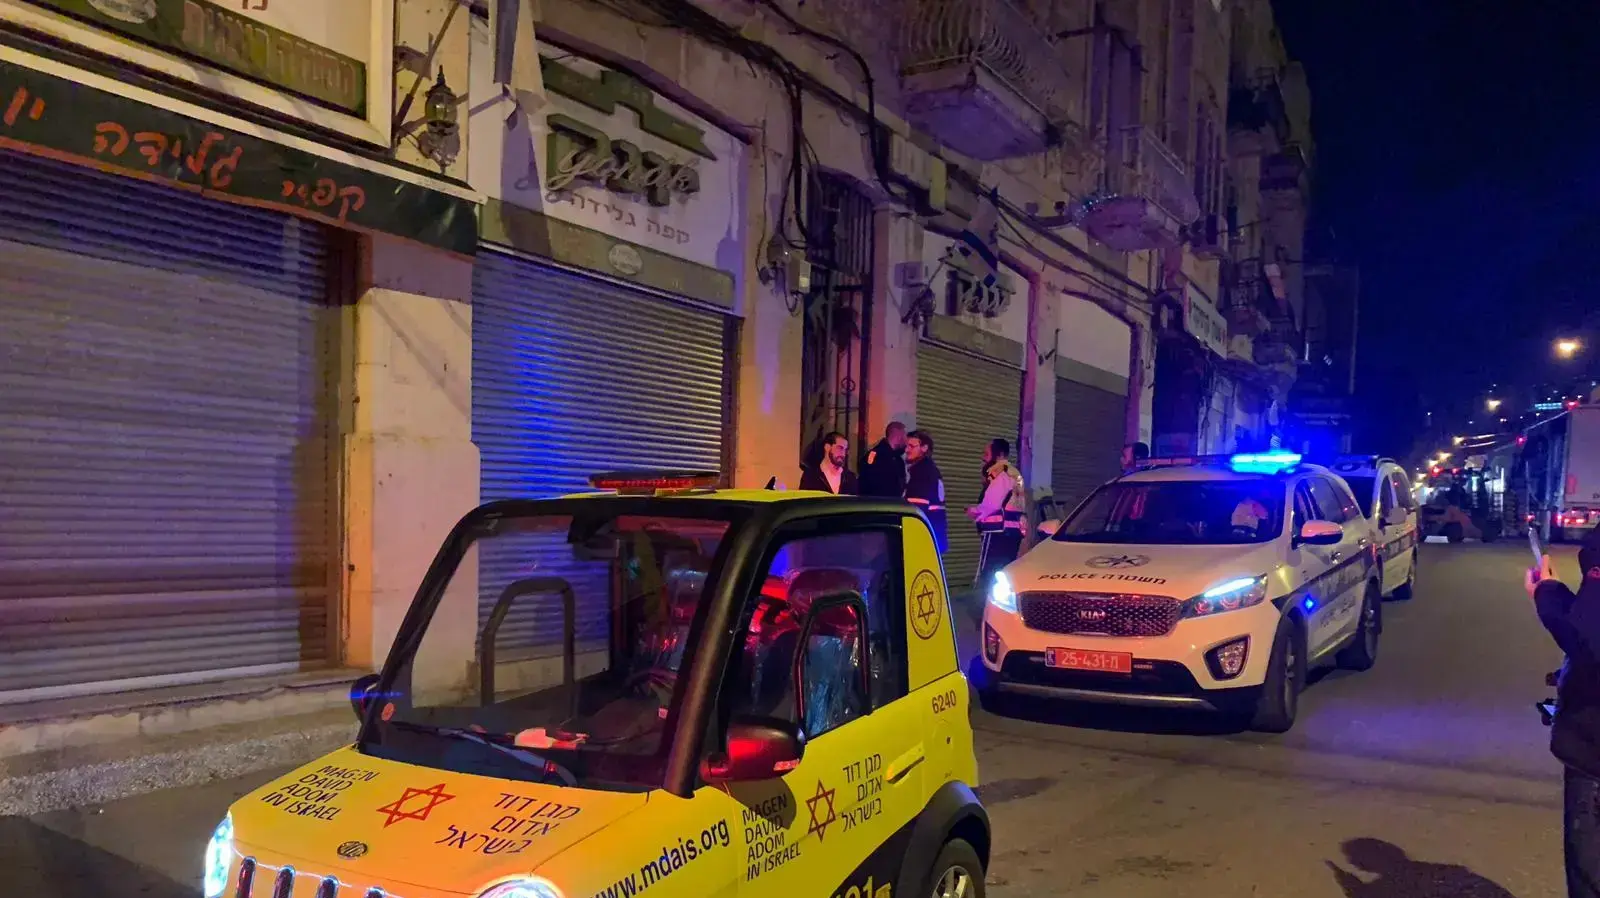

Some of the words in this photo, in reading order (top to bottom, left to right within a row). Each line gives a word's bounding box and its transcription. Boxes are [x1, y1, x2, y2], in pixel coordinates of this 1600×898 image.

[94, 121, 243, 188] גלידה
[569, 191, 637, 228] גלידה
[647, 216, 691, 245] קפה
[1038, 572, 1099, 581] POLICE
[1101, 573, 1168, 585] משטרה
[1080, 609, 1102, 620] KIA
[932, 689, 957, 714] 6240
[316, 765, 380, 781] MAGEN
[842, 762, 861, 784] דוד
[865, 753, 881, 779] מגן
[280, 783, 338, 803] ADOM
[299, 773, 353, 791] DAVID
[857, 775, 882, 802] אדום
[261, 791, 290, 806] IN
[284, 801, 342, 820] ISRAEL
[494, 792, 537, 812] דוד
[530, 801, 581, 820] מגן
[742, 793, 787, 826] MAGEN
[841, 798, 882, 832] בישראל
[490, 815, 560, 836] אדום
[745, 815, 783, 844] DAVID
[434, 824, 533, 854] בישראל
[748, 832, 785, 864] ADOM
[747, 862, 760, 882] IN
[764, 841, 801, 873] ISRAEL
